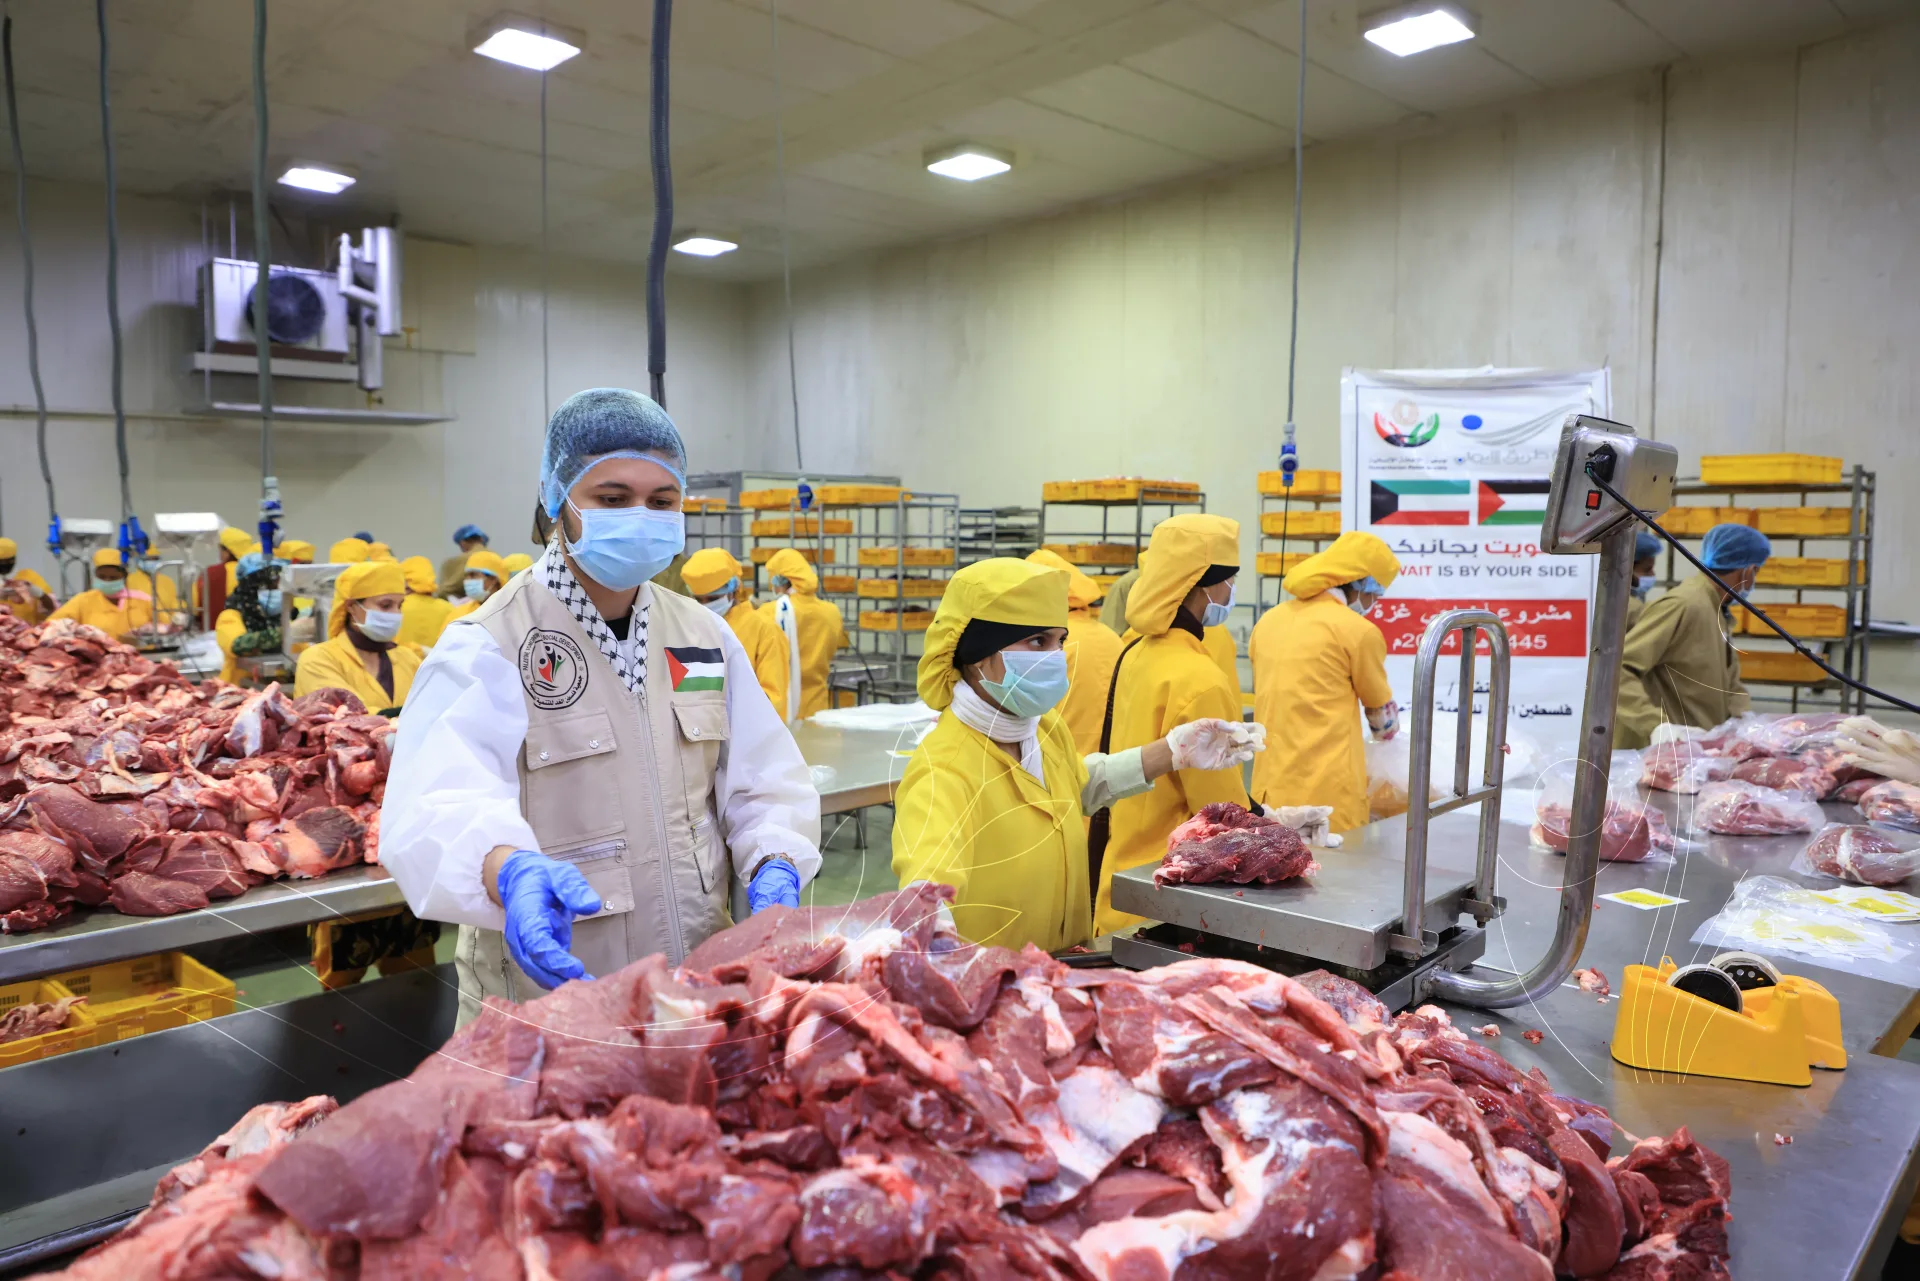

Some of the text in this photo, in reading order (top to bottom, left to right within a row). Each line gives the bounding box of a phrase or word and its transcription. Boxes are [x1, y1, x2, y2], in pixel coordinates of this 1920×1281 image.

[1387, 539, 1478, 557] بجانبك
[1438, 565, 1453, 577] IS
[1459, 565, 1480, 577] BY
[1486, 565, 1532, 577] YOUR
[1538, 565, 1579, 577] SIDE
[1519, 704, 1572, 719] فلسطين
